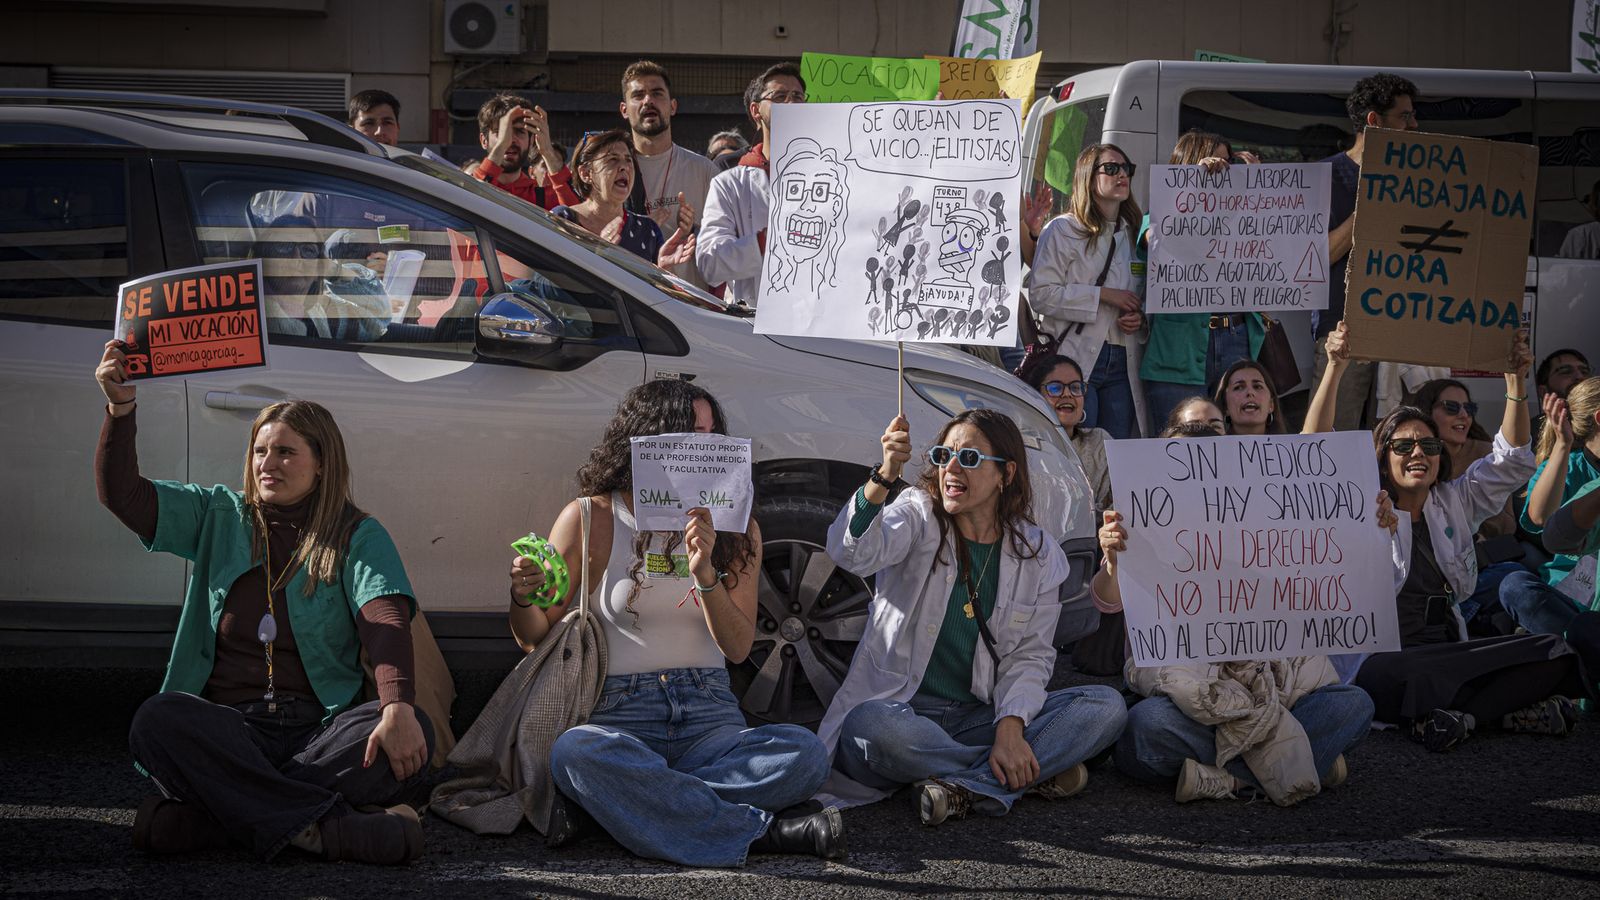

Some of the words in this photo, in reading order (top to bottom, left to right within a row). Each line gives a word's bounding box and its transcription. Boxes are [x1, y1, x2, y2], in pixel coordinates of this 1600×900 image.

[984, 65, 1013, 82] QUE
[1129, 95, 1142, 110] A
[862, 108, 884, 133] SE
[893, 108, 961, 132] QUEJAN
[973, 109, 1003, 131] DE
[1384, 141, 1467, 176] HORA
[1165, 167, 1232, 190] JORNADA
[1246, 167, 1311, 190] LABORAL
[937, 188, 961, 196] TURNO
[1175, 191, 1217, 213] 60-90
[1219, 193, 1305, 213] HORAS/SEMANA
[1361, 172, 1527, 220] TRABAJADA
[1161, 214, 1231, 237] GUARDIAS
[1238, 213, 1324, 237] OBLIGATORIAS
[1206, 239, 1226, 259] 24
[1234, 239, 1274, 259] HORAS
[1156, 260, 1209, 283] MÉDICOS
[1215, 261, 1288, 284] AGOTADOS,
[1366, 249, 1448, 285] HORA
[123, 286, 153, 320] SE
[163, 272, 255, 313] VENDE
[1161, 286, 1225, 308] PACIENTES
[1231, 287, 1247, 307] EN
[1360, 287, 1521, 330] COTIZADA
[150, 324, 171, 344] MI
[179, 312, 254, 340] VOCACIÓN
[638, 441, 657, 449] POR
[673, 442, 717, 451] ESTATUTO
[718, 444, 748, 452] PROPIO
[653, 453, 665, 461] LA
[666, 453, 714, 462] PROFESIÓN
[716, 454, 747, 464] MÉDICA
[669, 465, 727, 474] FACULTATIVA
[1165, 441, 1218, 482] SIN
[1238, 437, 1337, 479] MÉDICOS
[1203, 486, 1251, 524] HAY
[1264, 480, 1366, 523] SANIDAD,
[1173, 529, 1222, 573] SIN
[1241, 527, 1343, 569] DERECHOS
[1217, 578, 1259, 614] HAY
[1273, 570, 1352, 612] MÉDICOS
[1132, 625, 1166, 661] ¡NO
[1176, 622, 1198, 659] AL
[1205, 619, 1288, 657] ESTATUTO
[1301, 612, 1377, 650] MARCO!
